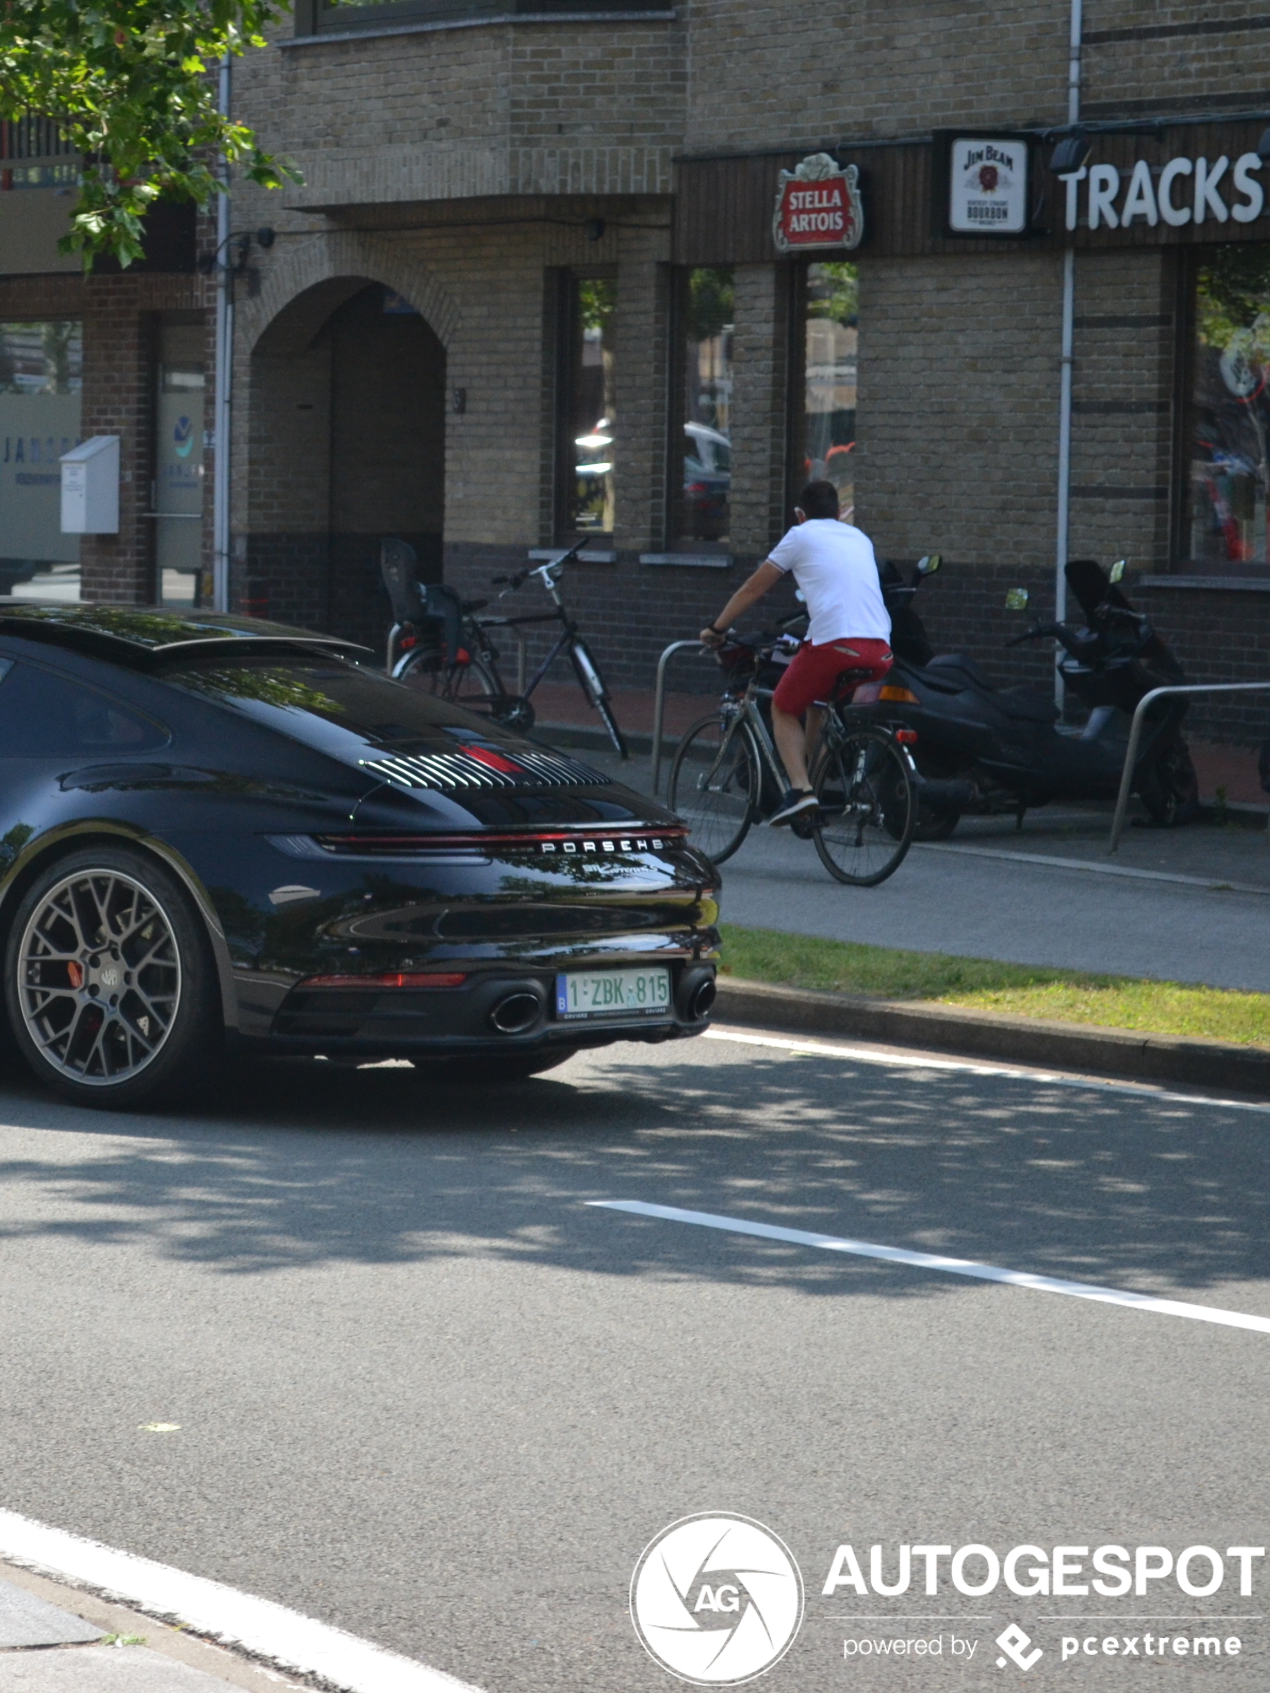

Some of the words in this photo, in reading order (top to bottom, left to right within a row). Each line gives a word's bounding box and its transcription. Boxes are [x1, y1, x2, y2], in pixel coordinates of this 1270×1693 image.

[964, 149, 985, 171] JIM
[986, 145, 1013, 171] BEAM
[789, 189, 843, 210] STELLA
[1058, 152, 1265, 231] TRACKS
[789, 211, 844, 232] ARTOIS
[967, 206, 1008, 219] BOURBON
[541, 839, 663, 853] PORSCHE
